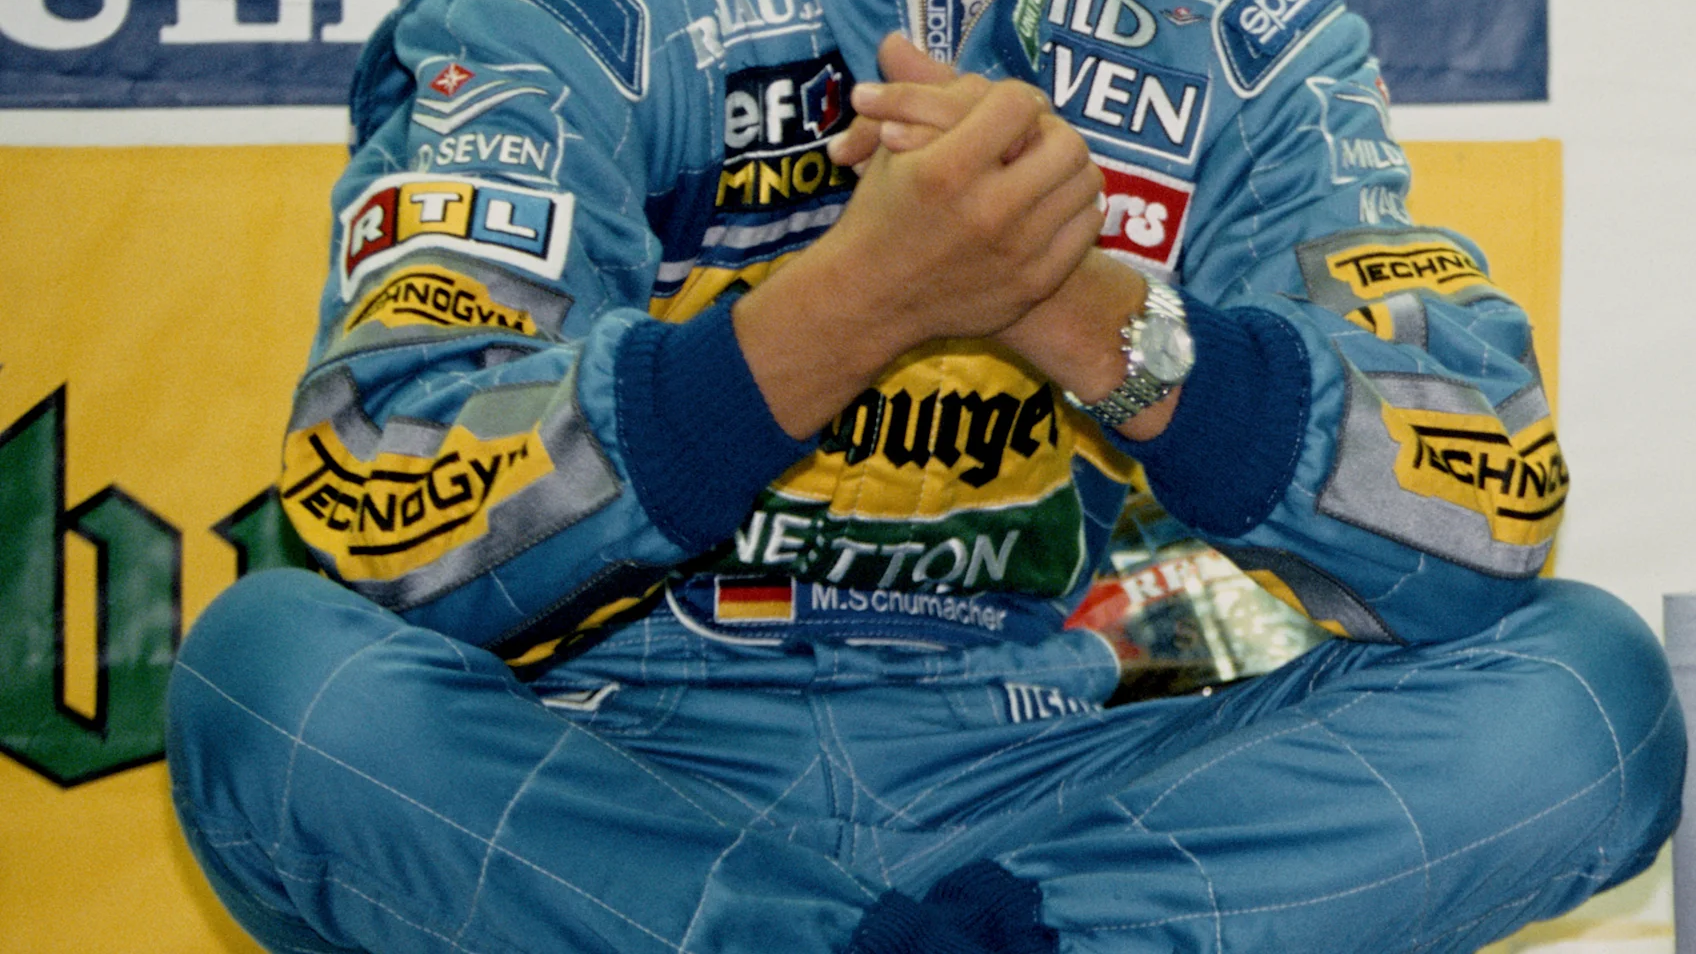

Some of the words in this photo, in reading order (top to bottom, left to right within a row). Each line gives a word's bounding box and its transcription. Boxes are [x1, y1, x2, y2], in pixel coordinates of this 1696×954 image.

[436, 132, 550, 172] SEVEN
[351, 192, 538, 258] RTL
[811, 582, 1008, 631] M.Schumacher
